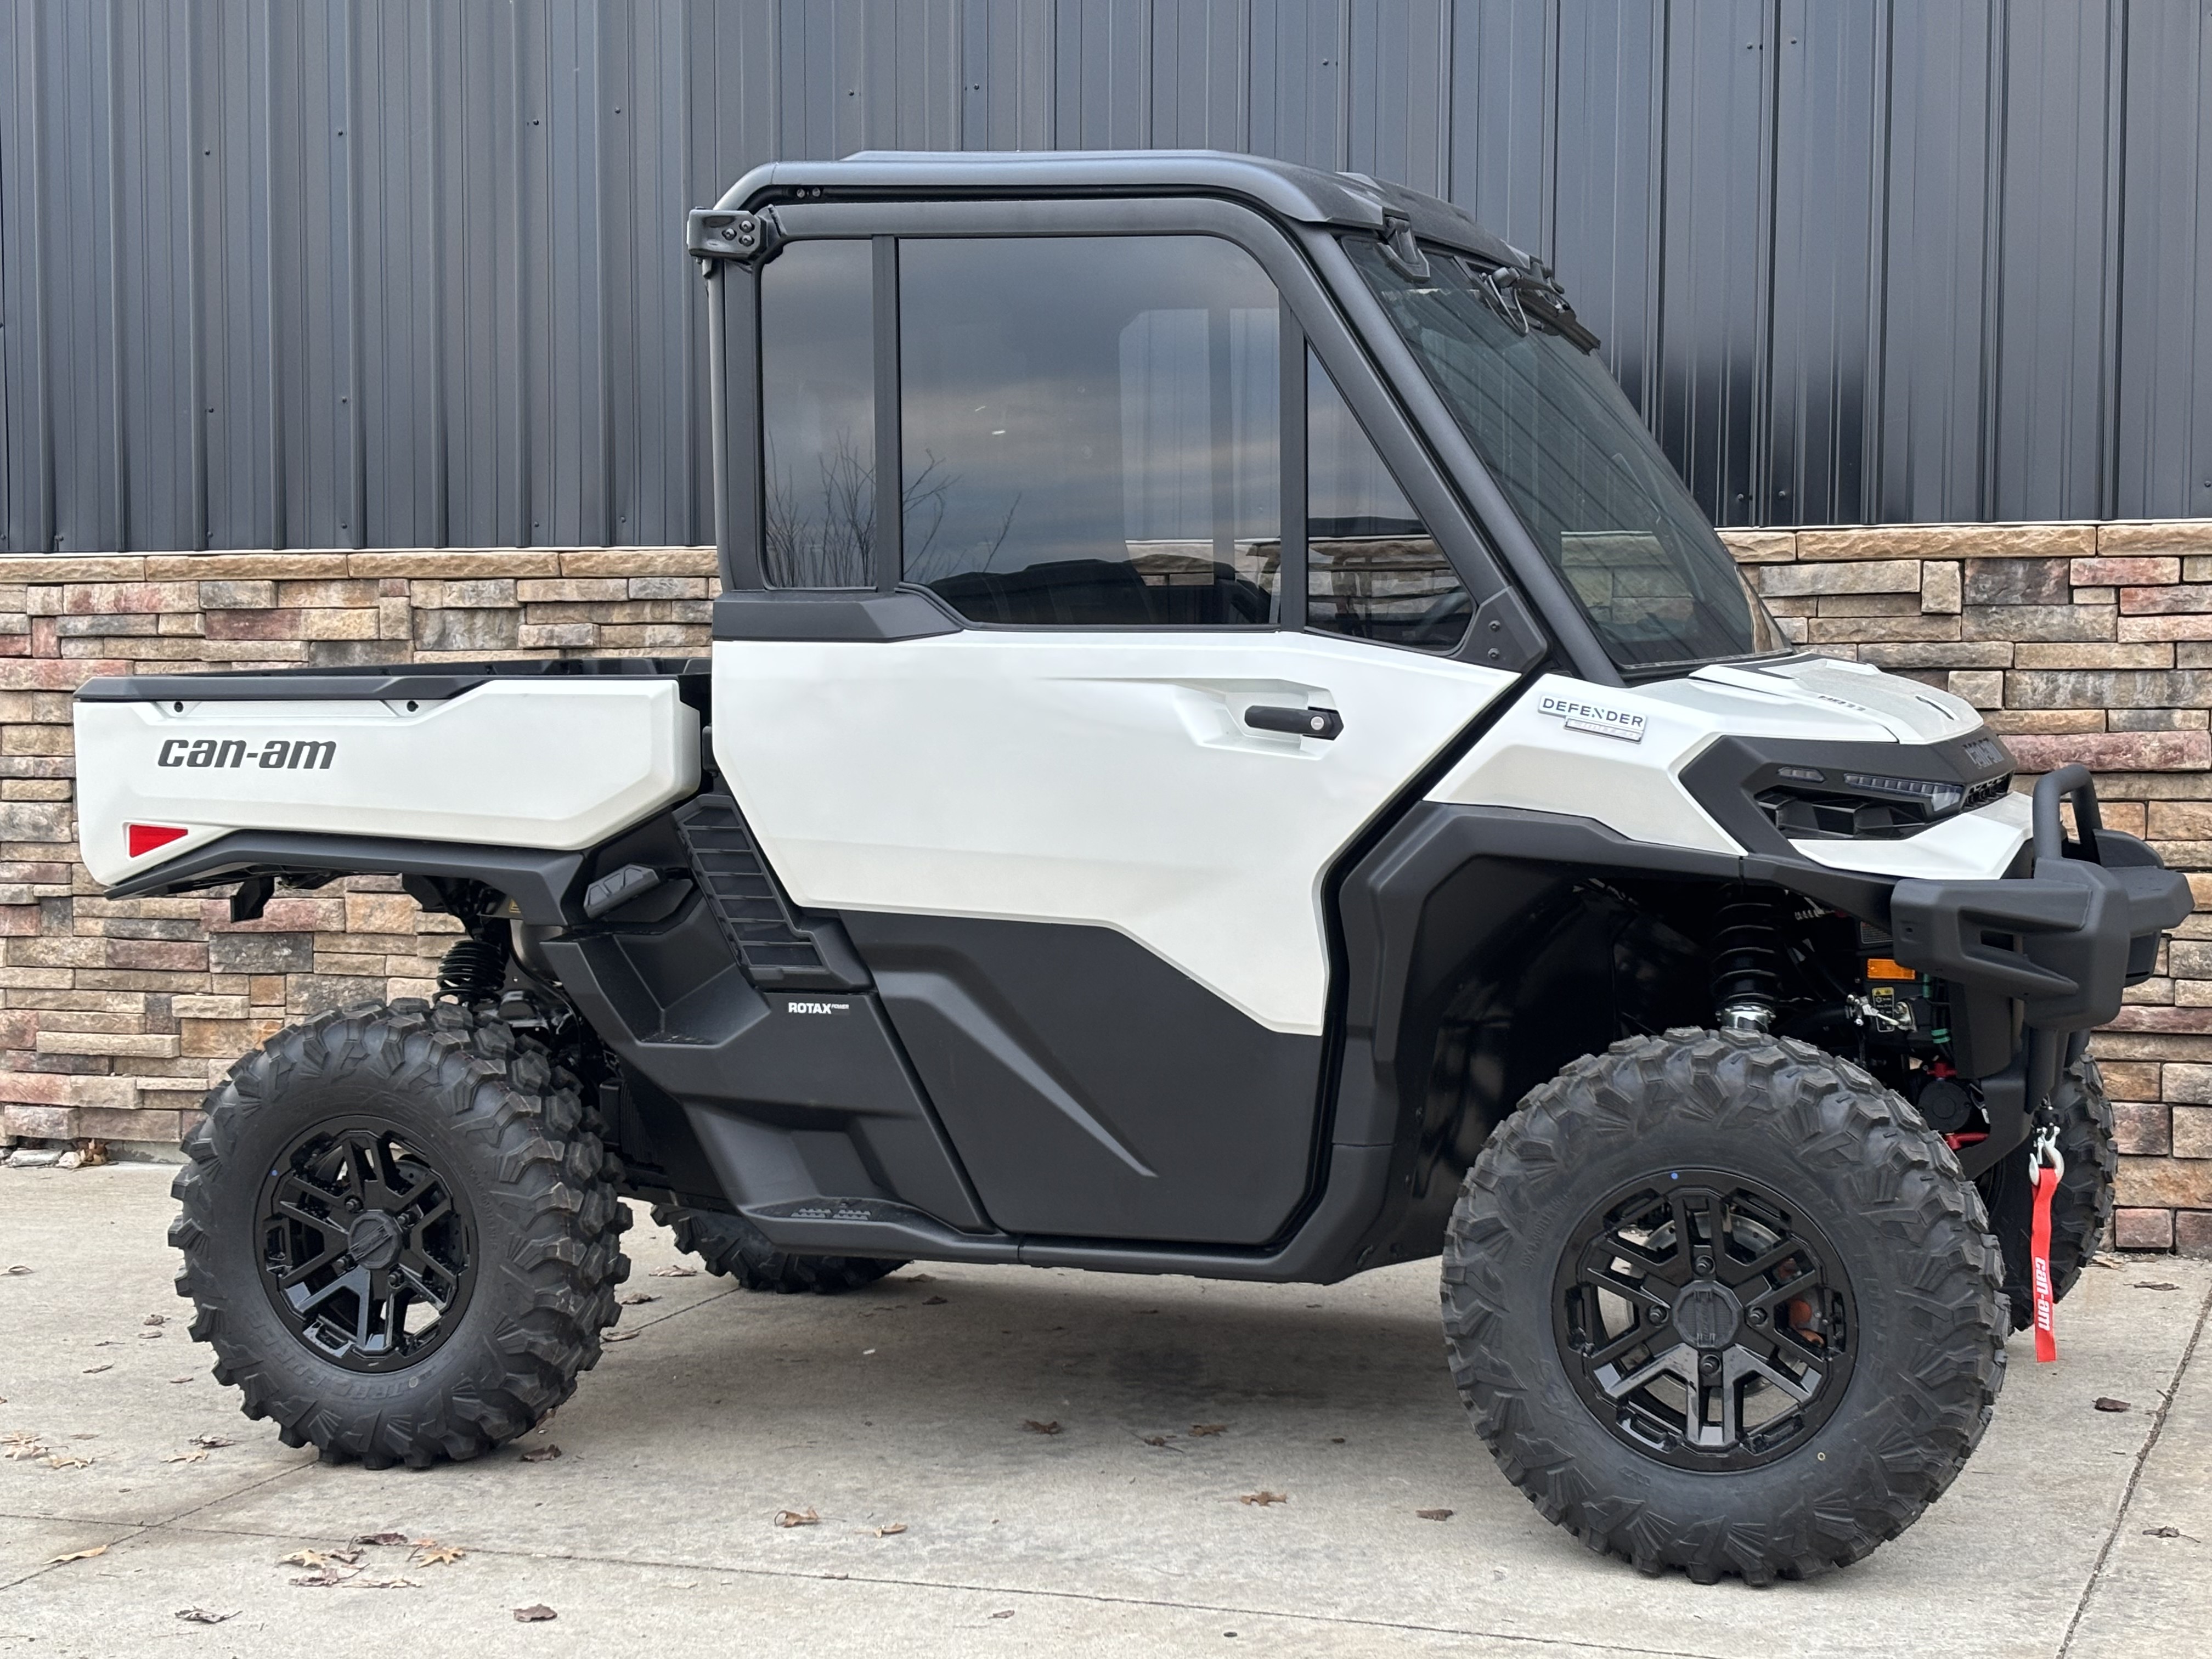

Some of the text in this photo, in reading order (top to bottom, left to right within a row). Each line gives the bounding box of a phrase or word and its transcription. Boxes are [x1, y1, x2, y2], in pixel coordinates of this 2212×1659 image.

[1542, 698, 1644, 727] DEFENDER
[157, 740, 337, 769] can-am
[788, 1002, 832, 1014] ROTAX
[2035, 1256, 2051, 1332] can-am
